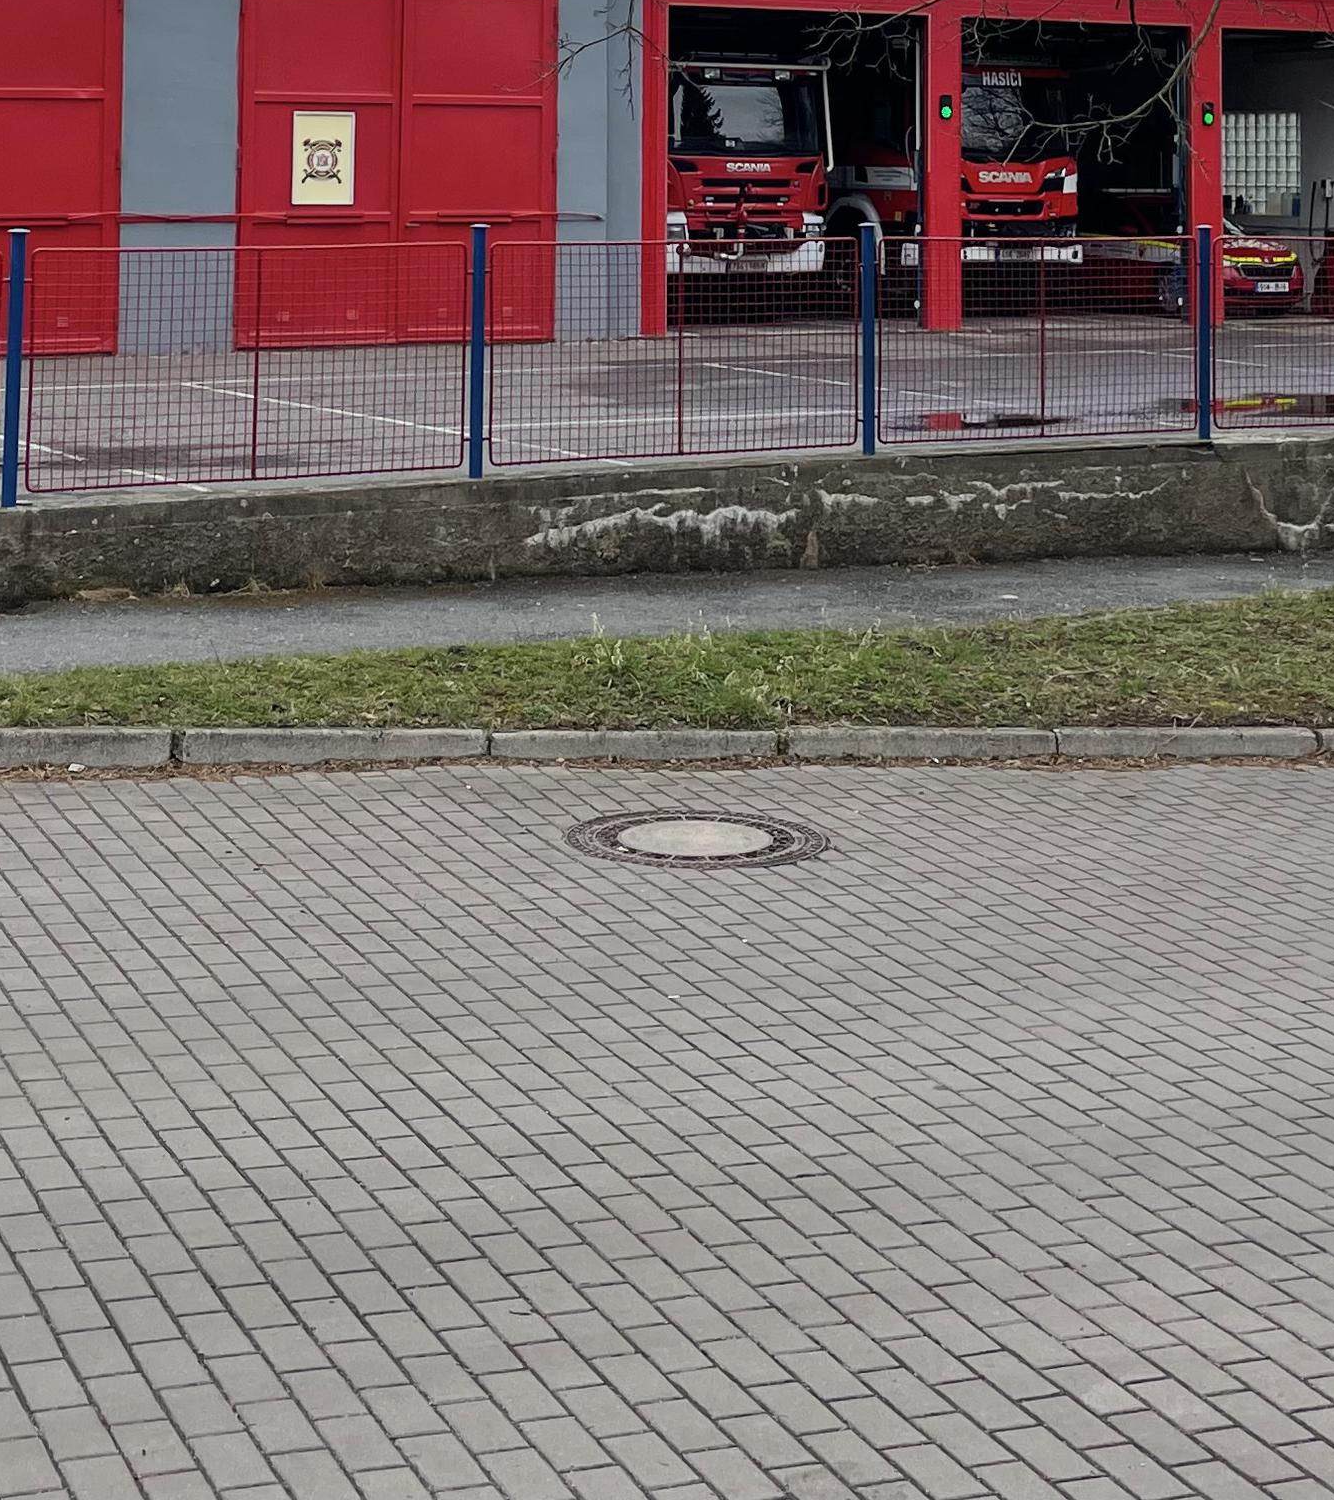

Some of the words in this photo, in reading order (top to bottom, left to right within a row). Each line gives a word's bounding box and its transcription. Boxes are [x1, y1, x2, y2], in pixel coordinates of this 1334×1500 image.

[982, 67, 1022, 87] HASIČI
[726, 162, 772, 173] SCANIA
[978, 171, 1033, 184] SCANIA
